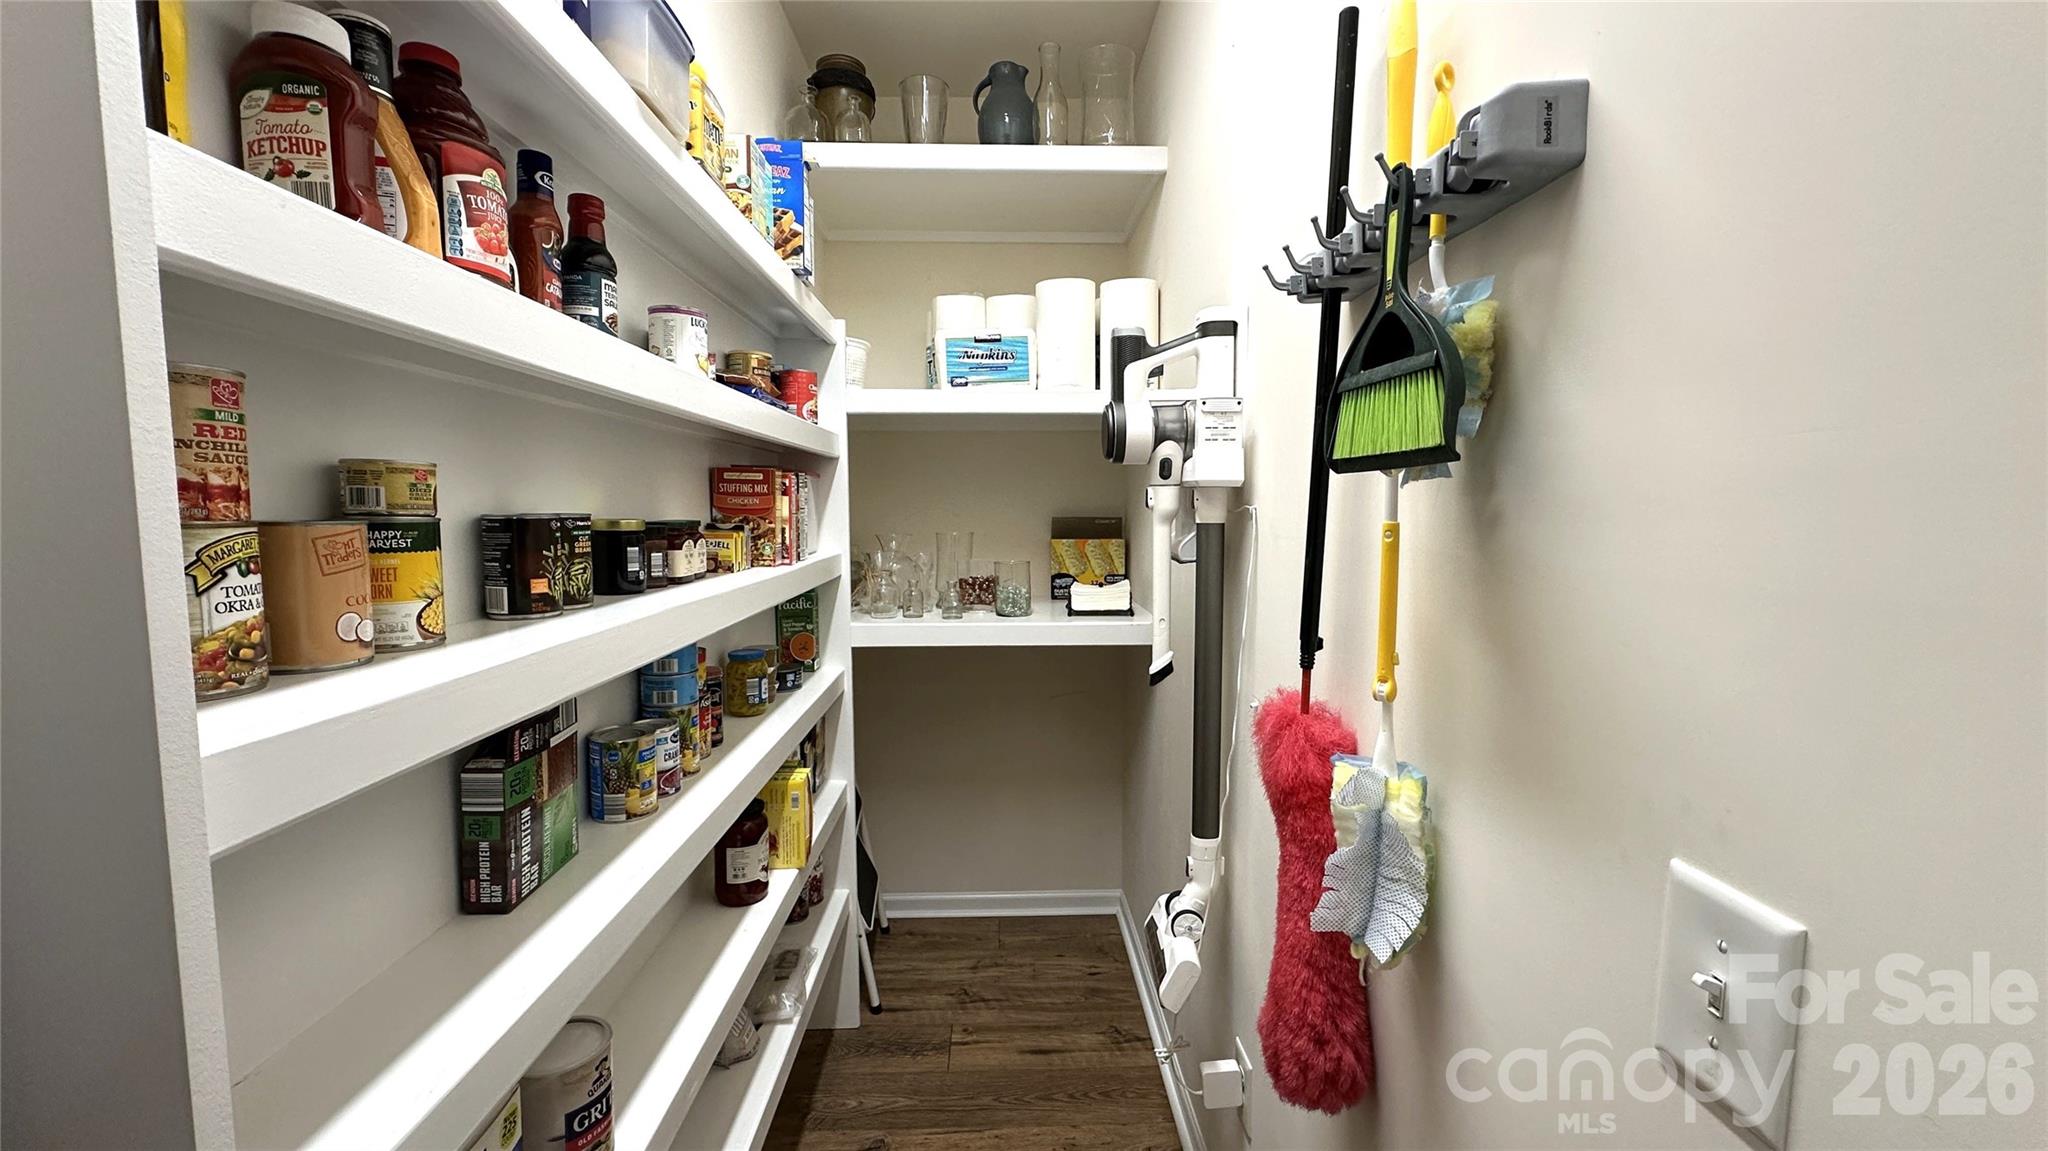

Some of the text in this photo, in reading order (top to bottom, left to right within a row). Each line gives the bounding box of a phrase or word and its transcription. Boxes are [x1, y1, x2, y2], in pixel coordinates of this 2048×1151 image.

[282, 83, 320, 96] ORGANIC
[255, 118, 314, 135] Tomato
[246, 135, 327, 158] KETCHUP
[957, 348, 1017, 361] Napkins
[214, 411, 239, 422] MILD
[719, 483, 769, 494] STUFFING MIX
[727, 497, 760, 505] CHICKEN
[206, 537, 257, 565] MARGARET
[367, 538, 413, 549] ARVEST
[370, 567, 398, 582] WEET
[220, 582, 262, 599] TOMAT
[370, 584, 393, 599] ORN
[214, 599, 255, 614] OKRA
[521, 806, 532, 897] HIGH PROTEIN
[479, 841, 490, 903] HIGH PROTEIN
[531, 862, 540, 889] BAR
[491, 885, 502, 903] BAR
[578, 1133, 592, 1146] OLD
